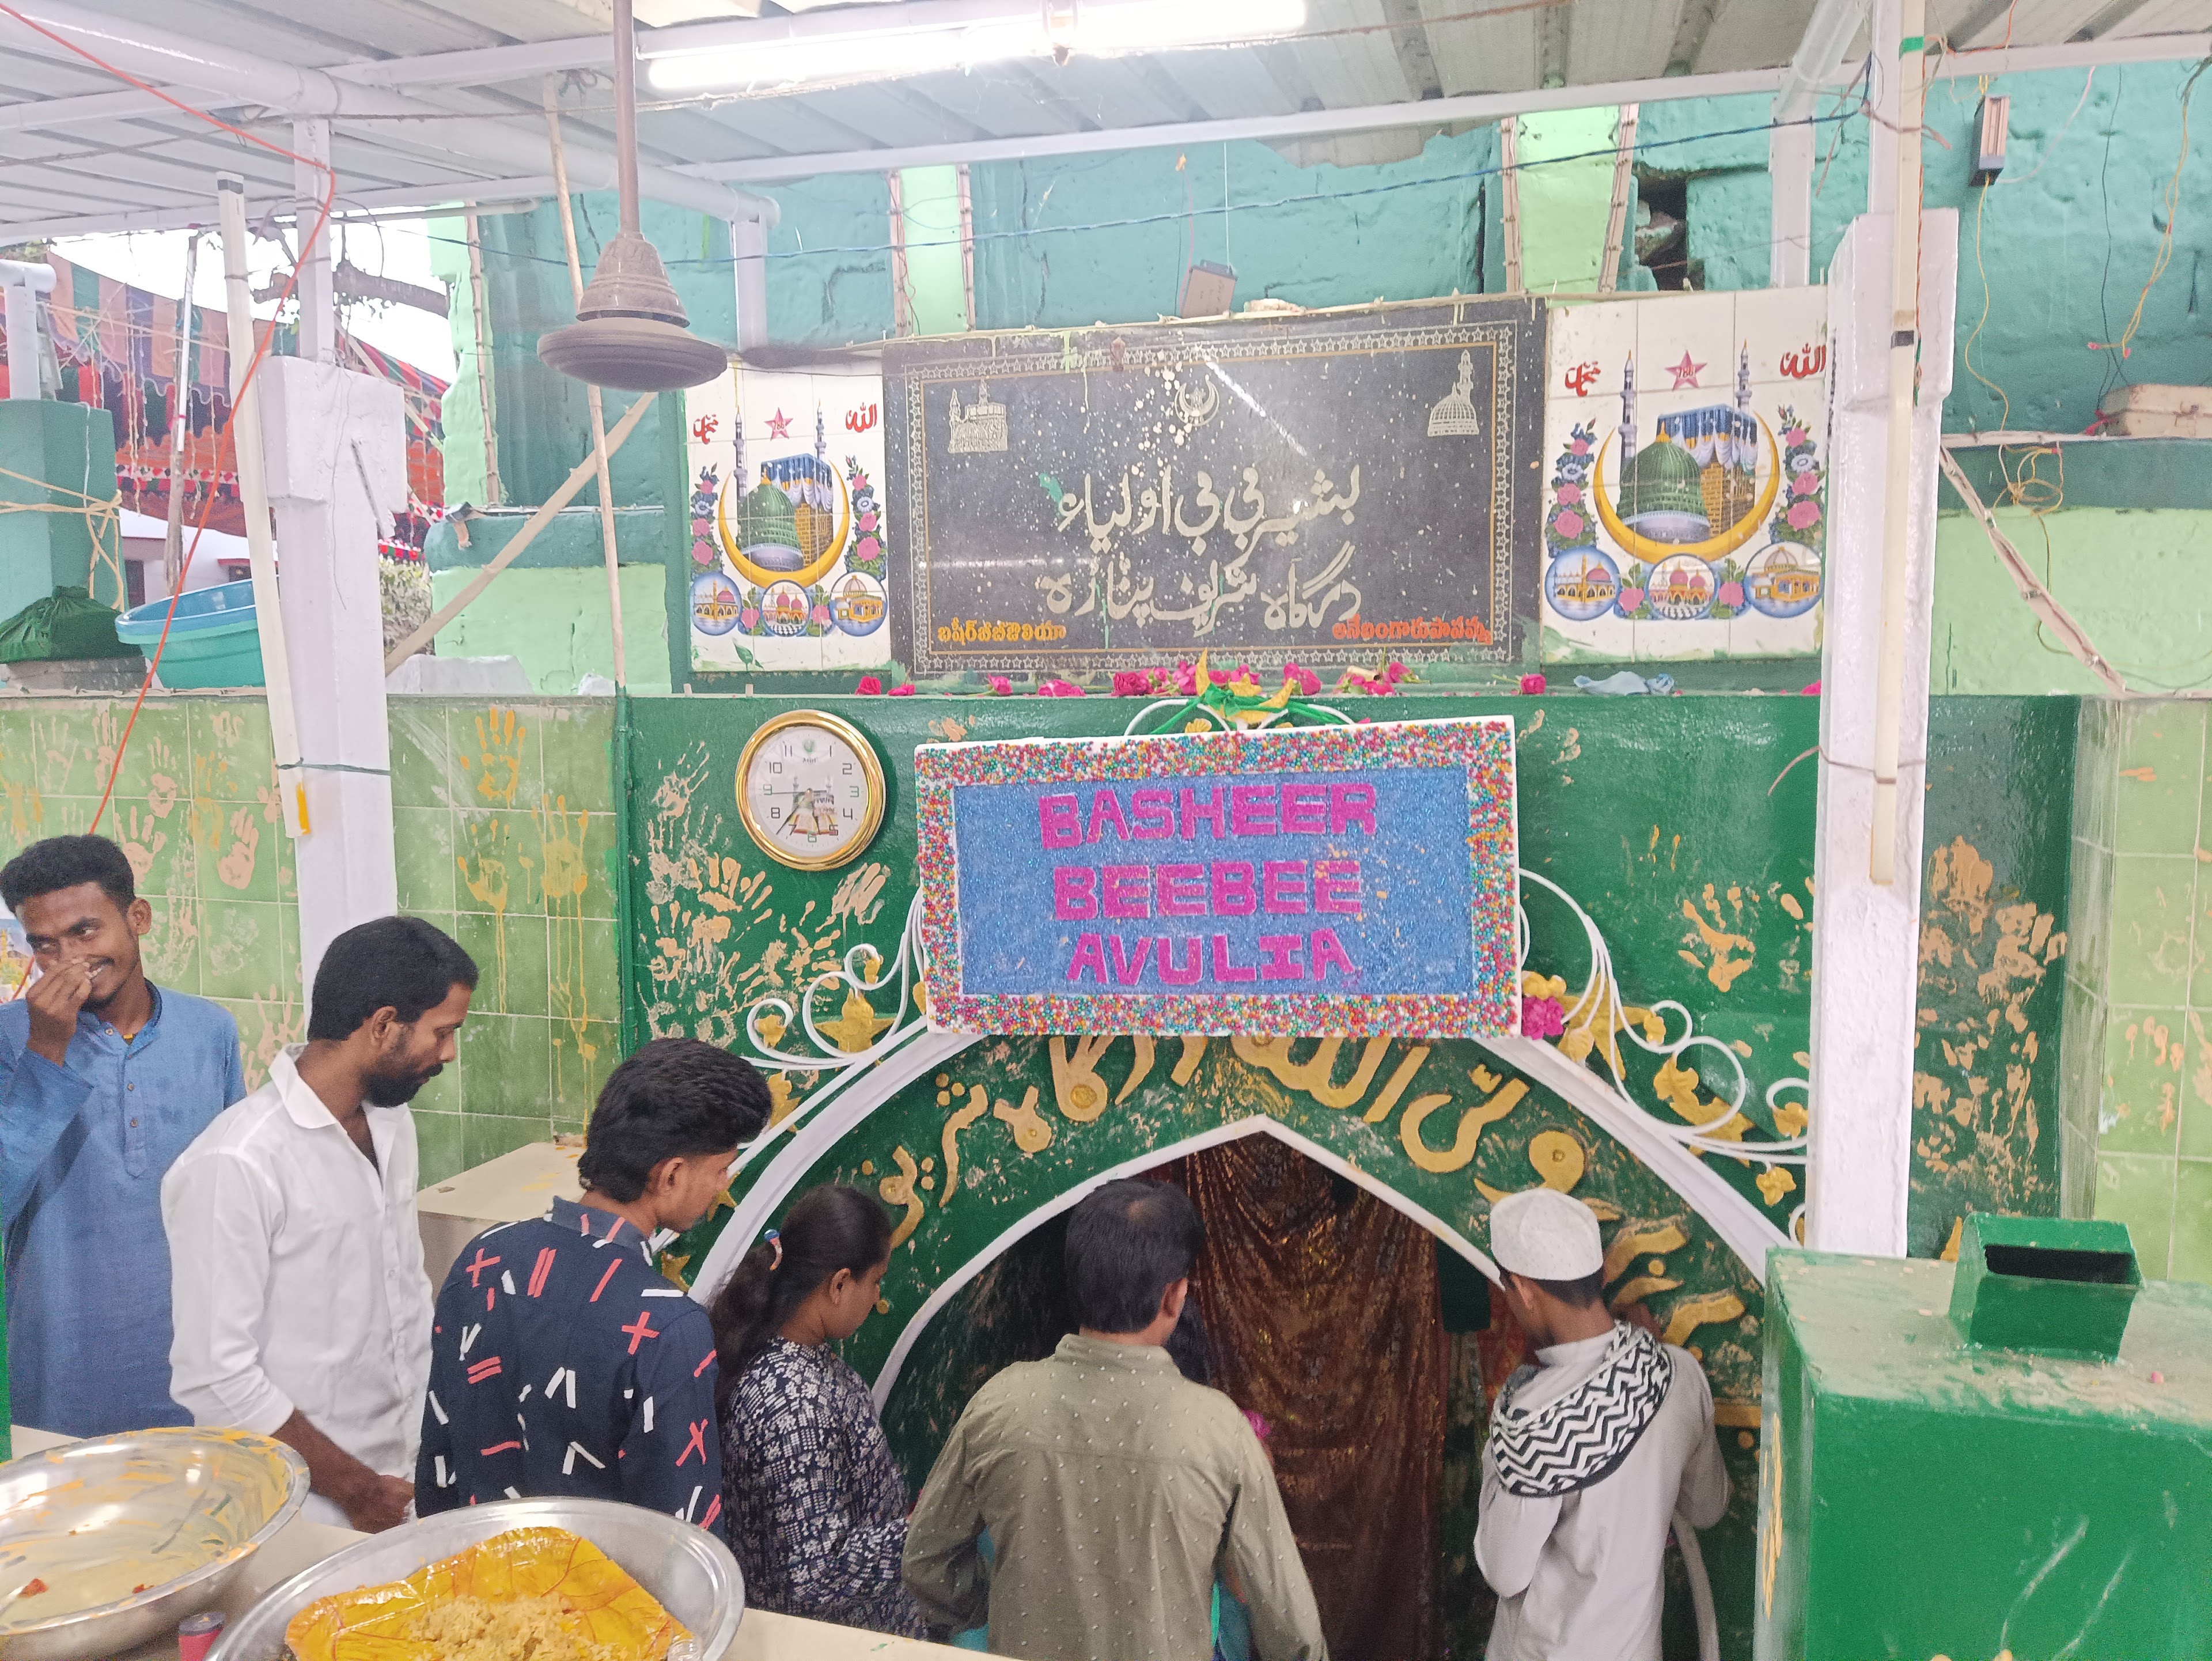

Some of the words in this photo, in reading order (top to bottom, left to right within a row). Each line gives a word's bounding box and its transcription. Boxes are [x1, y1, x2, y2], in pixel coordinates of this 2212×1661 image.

[785, 745, 793, 757] 11
[769, 762, 782, 774] 10
[843, 763, 853, 775] 2
[763, 784, 772, 795] 9
[850, 786, 859, 797] 3
[771, 807, 780, 819] 8
[843, 808, 853, 820] 4
[1038, 782, 1377, 849] BASHEER
[789, 824, 797, 835] 7
[829, 824, 838, 836] 5
[808, 831, 817, 843] 6
[1053, 860, 1362, 921] BEEBEE
[1066, 928, 1355, 986] AVULIA
